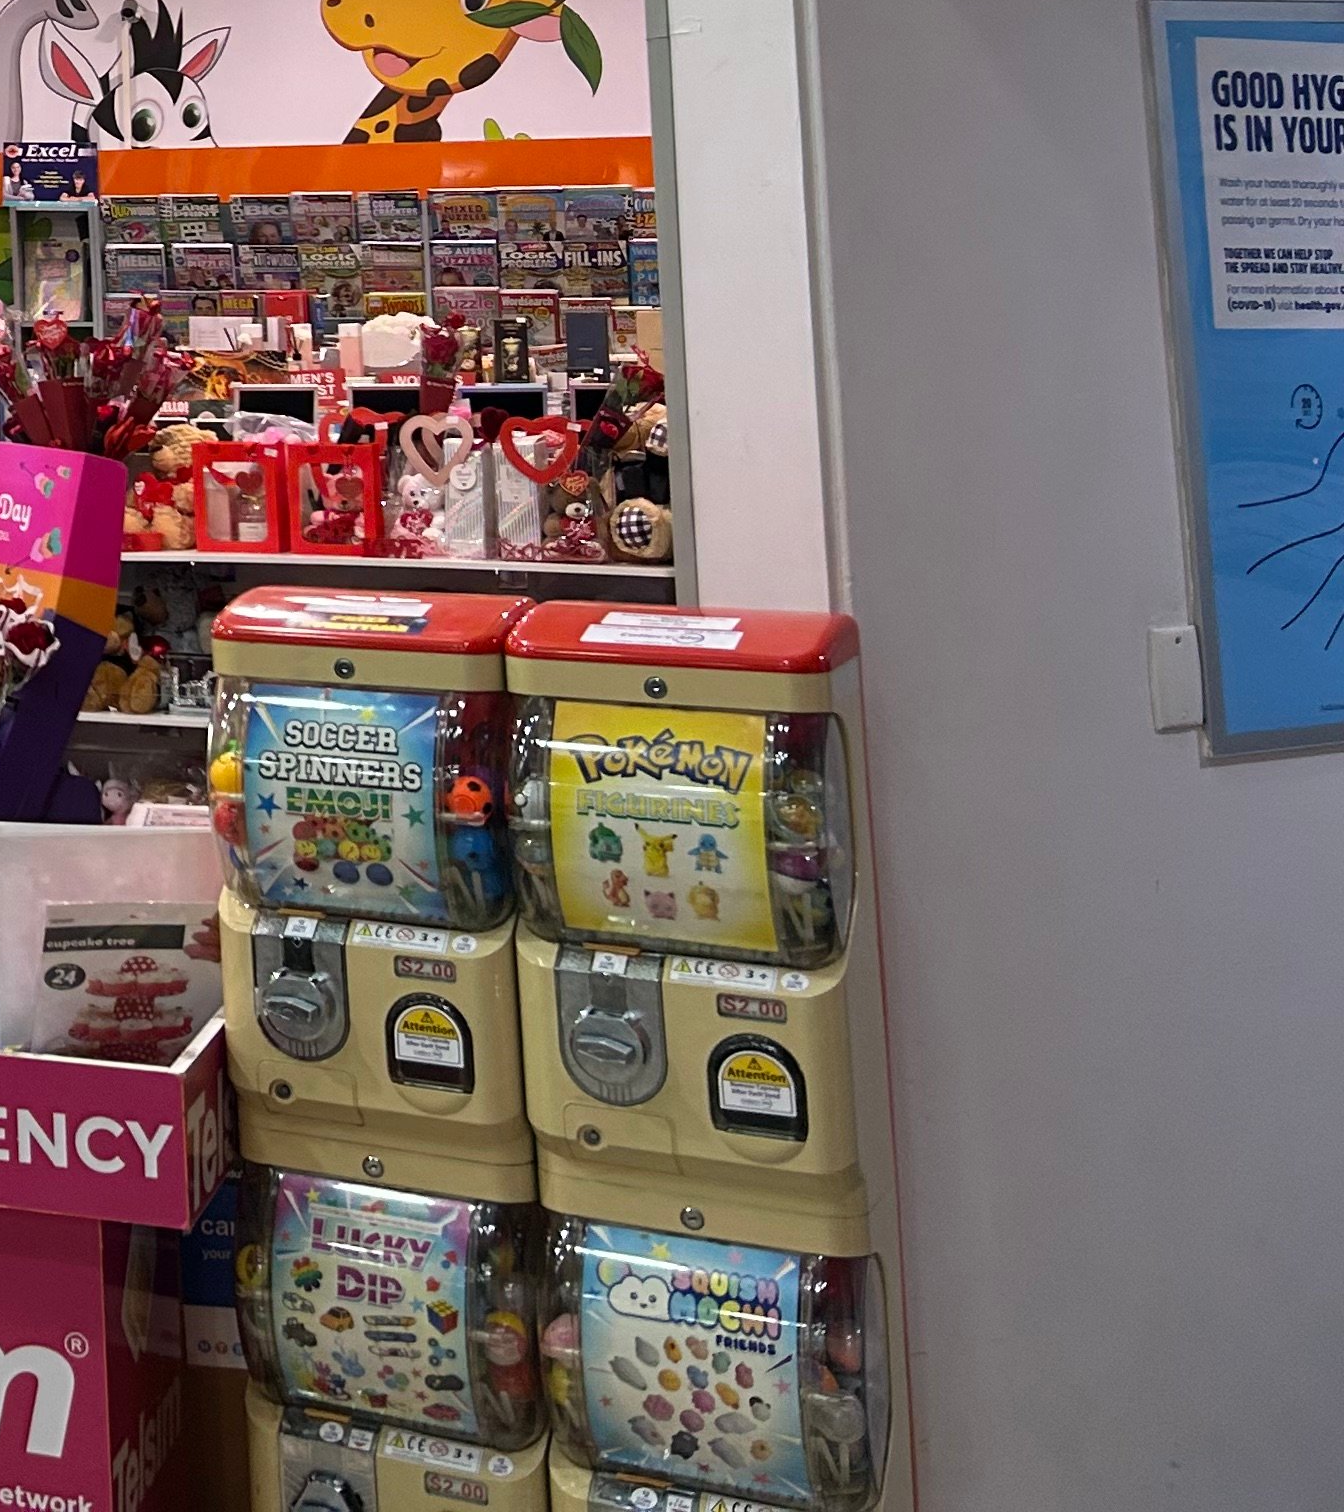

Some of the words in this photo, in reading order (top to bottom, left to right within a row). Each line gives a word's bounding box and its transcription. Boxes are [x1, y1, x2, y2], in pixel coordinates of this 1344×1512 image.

[1212, 70, 1284, 109] GOOD
[1292, 73, 1344, 111] HYG
[1214, 114, 1238, 151] IS
[1245, 115, 1273, 152] IN
[26, 144, 78, 158] Excel
[244, 205, 288, 216] BIG
[444, 204, 483, 214] MIXED
[301, 253, 357, 261] LOGIC
[454, 245, 494, 255] AUSSIE
[500, 251, 557, 260] LOGIC
[564, 250, 622, 267] FILL-INS
[1264, 248, 1276, 259] WE
[1277, 248, 1293, 260] CAN
[1294, 249, 1313, 260] HELP
[501, 259, 558, 269] PROBLEMS
[1224, 262, 1239, 273] THE
[1273, 263, 1289, 274] AND
[1290, 263, 1308, 274] STAY
[437, 296, 494, 310] Puzzle
[284, 719, 399, 755] SOCCER
[259, 750, 423, 792] SPINNERS
[285, 786, 394, 822] EMOJI
[576, 789, 741, 829] FIGURINES
[46, 936, 102, 950] cupcake
[107, 936, 136, 948] tree
[50, 968, 79, 985] 24
[402, 1020, 456, 1037] Attention
[727, 1067, 786, 1084] Attention
[311, 1217, 434, 1271] LUCKY
[336, 1264, 406, 1309] DIP
[672, 1267, 780, 1306] SQUISH
[668, 1291, 782, 1340] MOCHI
[715, 1334, 777, 1355] FRIENDS
